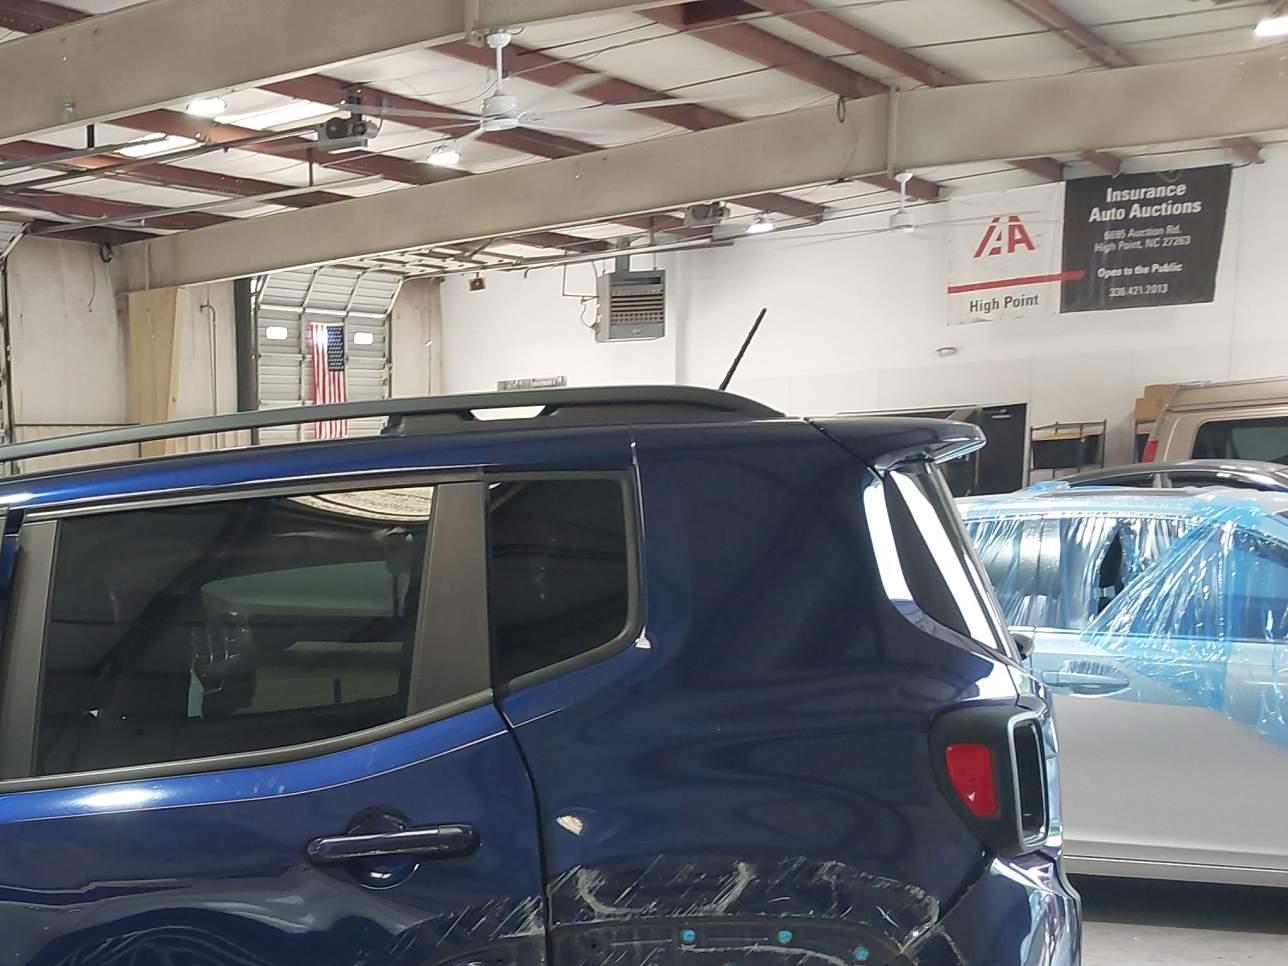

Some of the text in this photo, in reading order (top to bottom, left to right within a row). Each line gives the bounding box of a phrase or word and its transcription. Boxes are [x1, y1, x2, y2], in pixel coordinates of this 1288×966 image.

[1106, 183, 1187, 203] Insurance
[1088, 199, 1202, 223] Auto Auctions
[1094, 241, 1116, 254] High
[1145, 237, 1161, 248] NC
[1097, 261, 1184, 280] Open to the Public
[969, 294, 1039, 314] High Point
